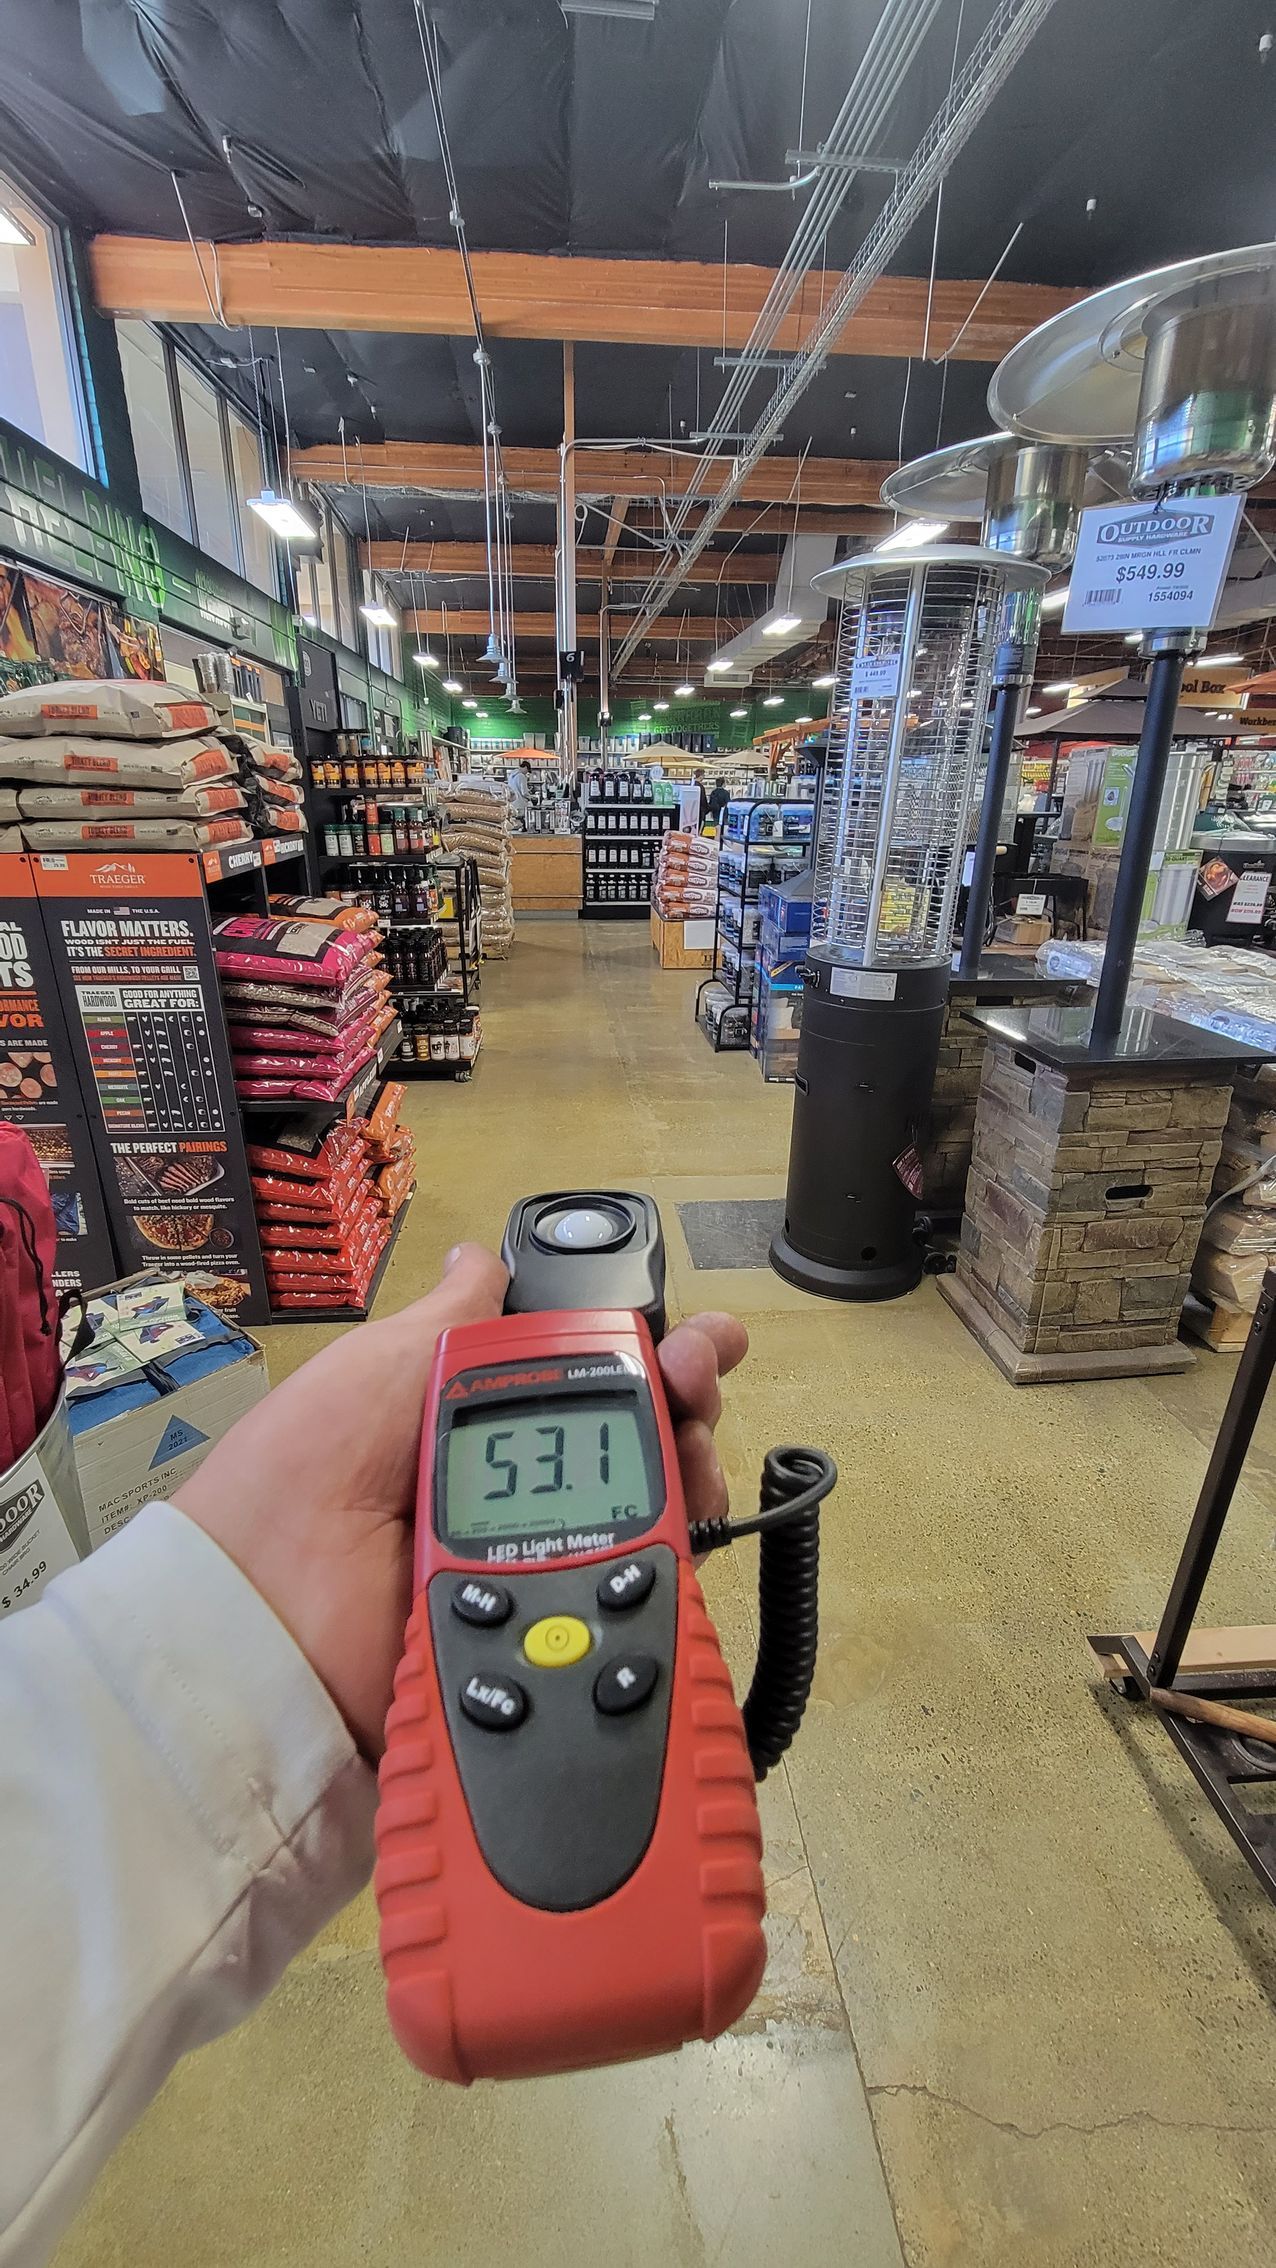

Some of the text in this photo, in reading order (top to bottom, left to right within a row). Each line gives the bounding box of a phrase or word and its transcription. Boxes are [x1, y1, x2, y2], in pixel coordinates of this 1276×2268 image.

[1100, 515, 1209, 543] OUTDOOR
[1118, 531, 1189, 543] SUPPLY HARDWARE
[1115, 562, 1185, 583] $549.99
[1148, 590, 1195, 602] 1554094
[566, 653, 575, 662] 6
[1200, 681, 1226, 694] Box
[309, 699, 328, 723] YETI
[228, 851, 253, 869] CHERRY
[90, 874, 145, 884] TRAEGER
[60, 920, 194, 937] FLAVOR MATTERS.
[67, 946, 197, 957] IT'S THE SECRET INGREDIENT.
[71, 966, 181, 975] FROM OUR MILLS, TO YOUR GRILL
[83, 995, 117, 1007] HARDWOOD
[123, 990, 197, 998] GOOD FOR ANYTHING
[124, 999, 199, 1008] GREAT FOR:
[110, 1141, 228, 1153] THE PERFECT PAIRINGS
[471, 1368, 562, 1392] AMPROBE
[168, 1436, 188, 1450] 2021
[170, 1430, 183, 1441] MS
[484, 1422, 610, 1500] 53.1
[98, 1467, 177, 1512] MAC SPORTS INC
[136, 1484, 168, 1506] XP-200
[611, 1504, 638, 1519] FC
[487, 1532, 615, 1562] LED Light Meter
[1, 1560, 47, 1609] $ 34.99
[609, 1563, 642, 1594] D-H
[461, 1583, 497, 1612] M-H
[616, 1667, 636, 1689] R
